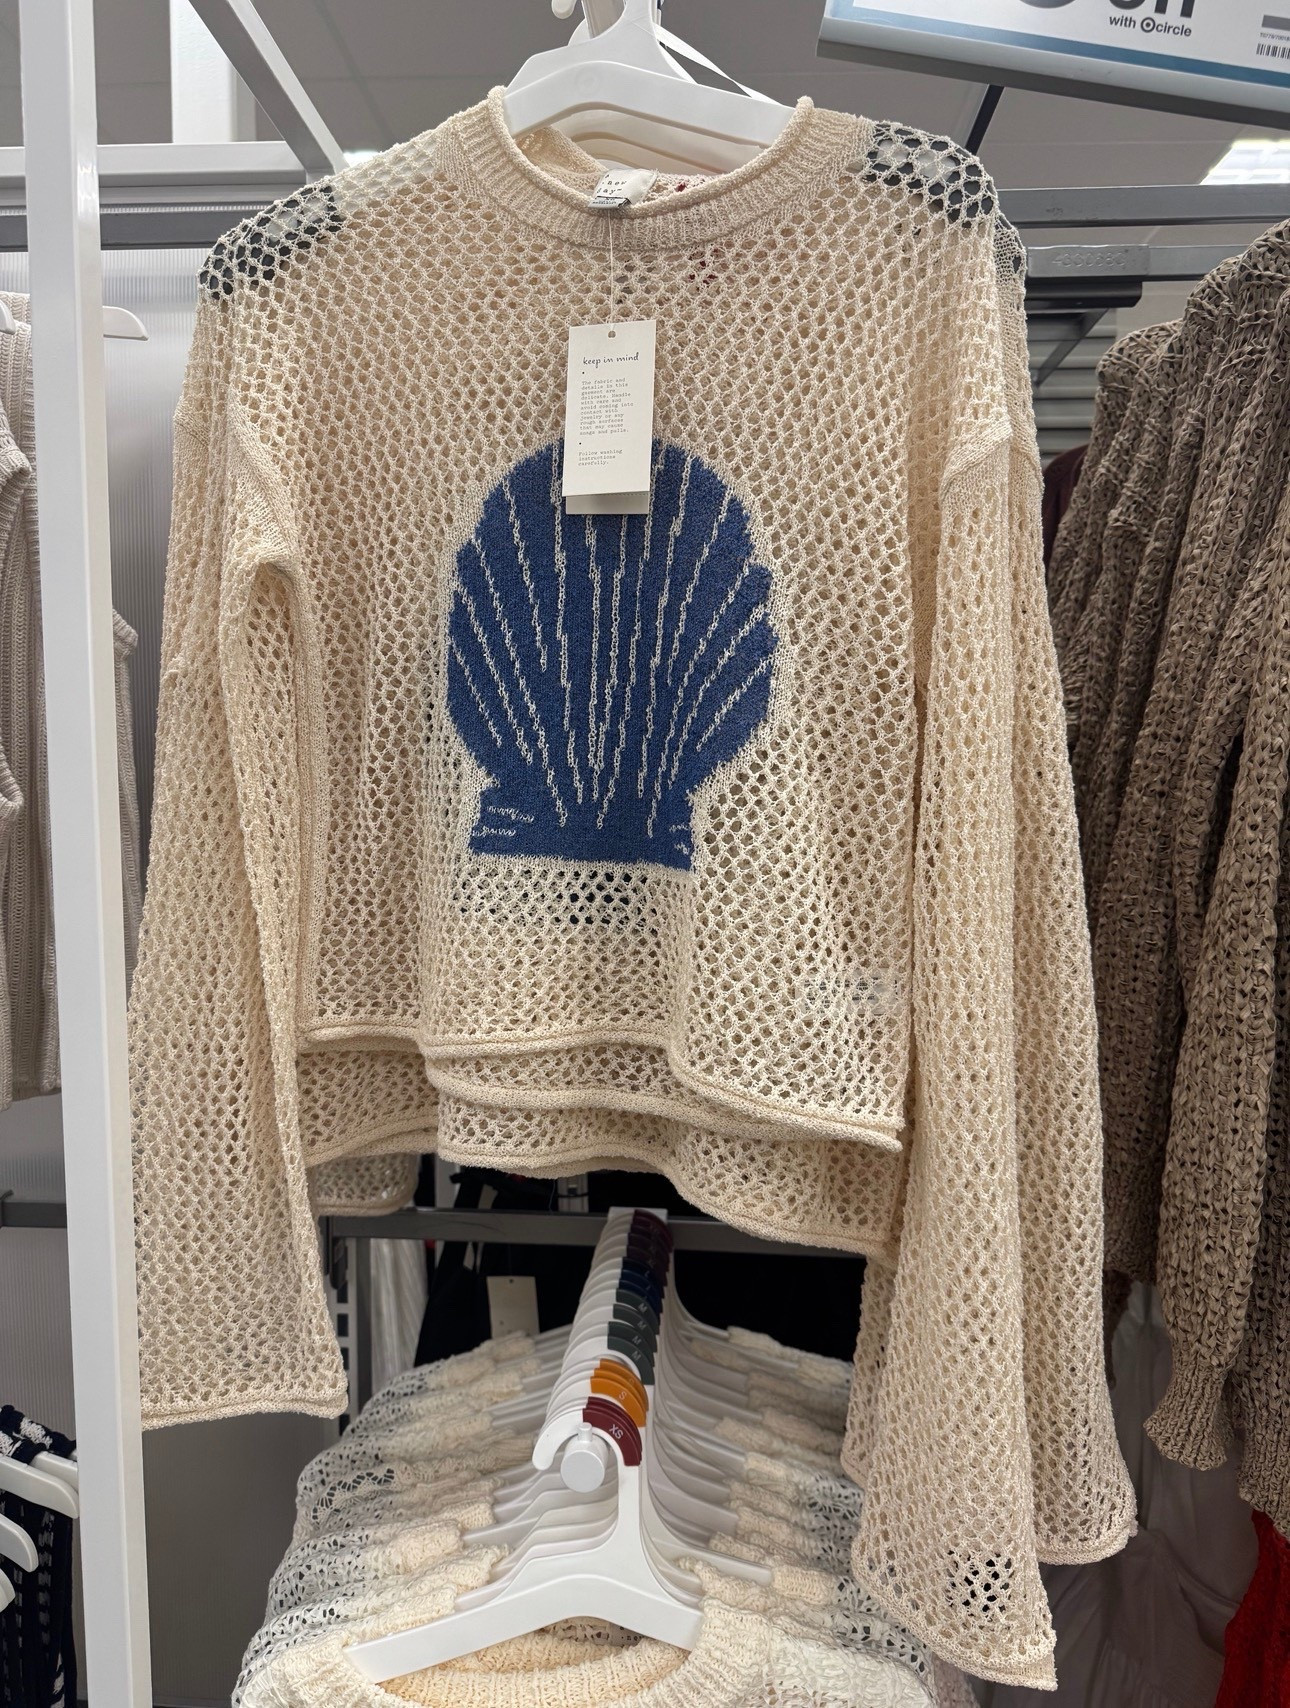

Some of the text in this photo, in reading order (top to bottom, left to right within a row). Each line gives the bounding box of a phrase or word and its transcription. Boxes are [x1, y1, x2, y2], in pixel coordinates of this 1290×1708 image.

[1109, 15, 1192, 37] with circle
[583, 356, 601, 369] keep
[616, 351, 639, 362] mind
[638, 1302, 648, 1313] M
[637, 1320, 647, 1330] M
[632, 1335, 642, 1346] M
[631, 1350, 642, 1361] M
[618, 1391, 627, 1401] S
[609, 1424, 624, 1440] XS
